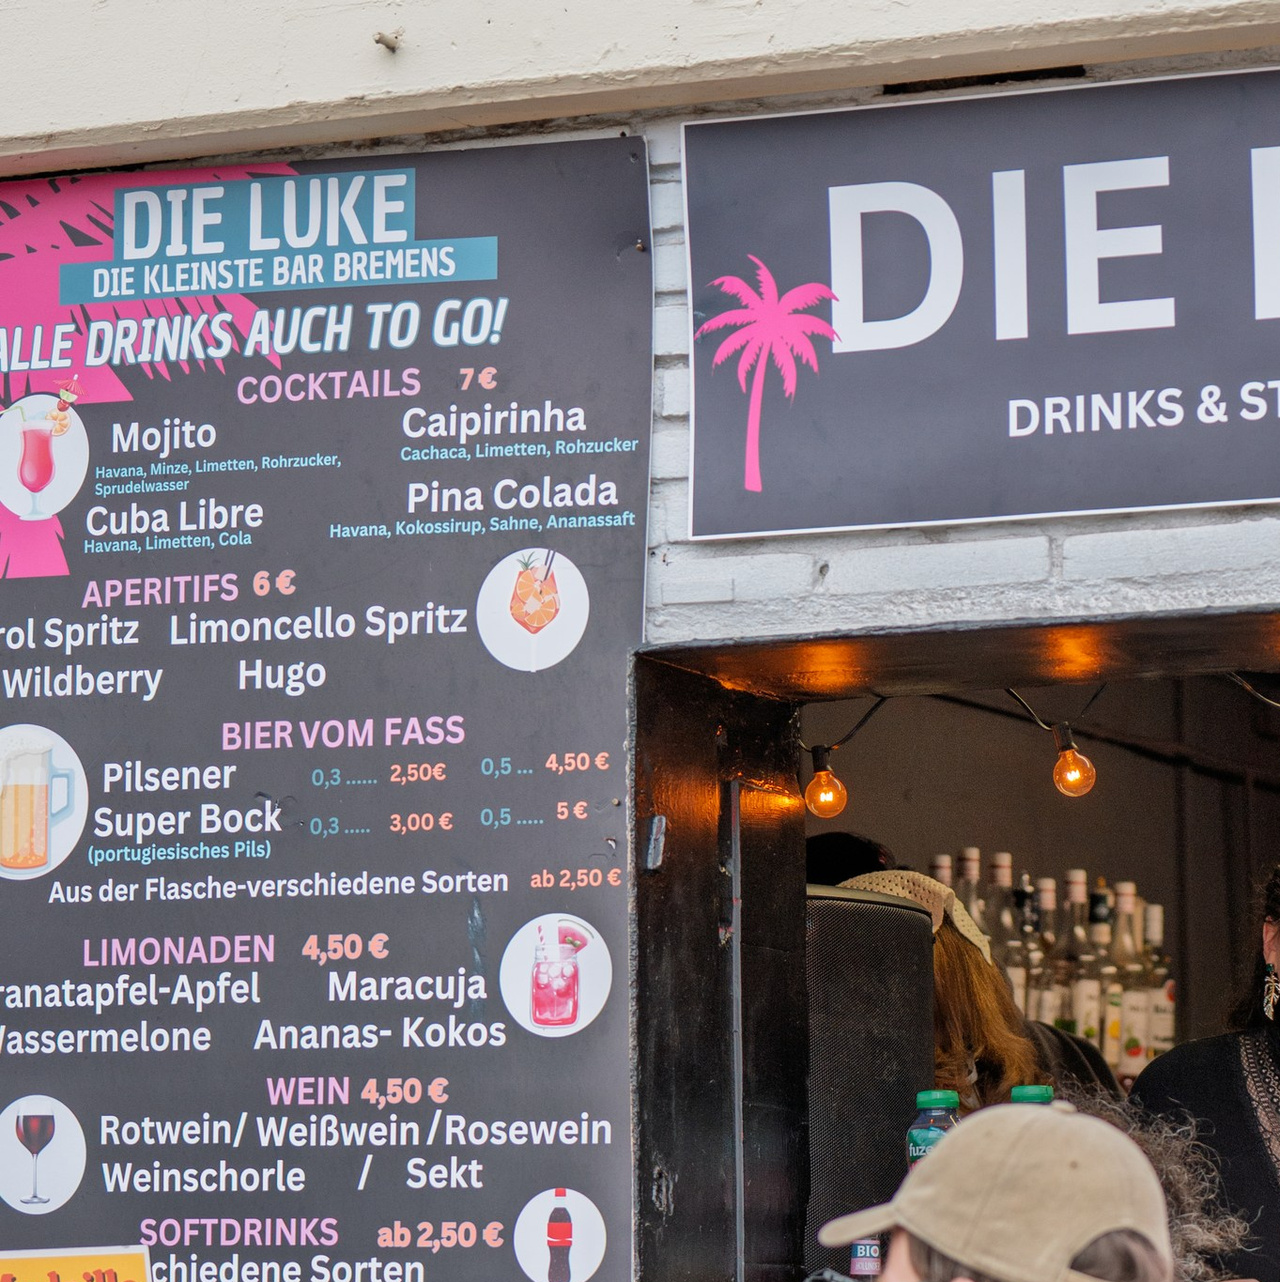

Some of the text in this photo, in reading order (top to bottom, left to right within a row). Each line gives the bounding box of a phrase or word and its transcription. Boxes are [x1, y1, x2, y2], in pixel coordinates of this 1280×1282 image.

[124, 173, 407, 259] DIE LUKE
[94, 247, 455, 297] DIE KLEINSTE BAR BREMENS
[822, 156, 1175, 353] DIE
[86, 313, 232, 365] DRINKS
[245, 306, 352, 355] AUCH
[368, 303, 419, 348] TO
[434, 299, 507, 345] GO!
[238, 368, 420, 404] COCKTAILS
[403, 401, 586, 444] Caipirinha
[1009, 388, 1184, 437] DRINKS
[1197, 385, 1228, 423] &
[113, 418, 216, 458] Mojito
[401, 438, 638, 461] Cachaca, Limetten, Rohzucker
[96, 453, 341, 478] Havana, Minze, Limetten, Rohrzucker,
[96, 480, 189, 498] Sprudelwasser
[408, 474, 618, 513] Pina Colada
[87, 498, 263, 538] Cuba Libre
[330, 511, 635, 538] Havana, Kokossirup, Sahne, Ananassaft
[85, 531, 251, 553] Havana, Limetten, Cola
[82, 574, 238, 608] APERITIFS
[44, 614, 138, 655] Spritz
[171, 602, 467, 644] Limoncello Spritz
[3, 665, 163, 701] Wildberry
[239, 660, 326, 696] Hugo
[223, 716, 465, 750] BIER VOM FASS
[104, 753, 590, 792] Pilsener 2,50€ 4,50
[94, 800, 434, 844] Super Bock 3,00
[88, 840, 270, 866] (portugiesisches Pils)
[49, 869, 602, 903] Aus der Flasche-verschiedene Sorten 2,50
[84, 934, 362, 966] LIMONADEN 4,50
[0, 972, 260, 1014] ranatapfel-Apfel
[329, 967, 487, 1007] Maracuja
[0, 1021, 210, 1054] assermelone
[403, 1015, 506, 1047] Kokos
[267, 1077, 422, 1109] WEIN 4,50
[256, 1114, 419, 1146] Weißwein
[102, 1156, 483, 1192] Weinschorle Sekt
[139, 1218, 476, 1253] SOFTDRINKS 2,50
[857, 1245, 880, 1257] BIO
